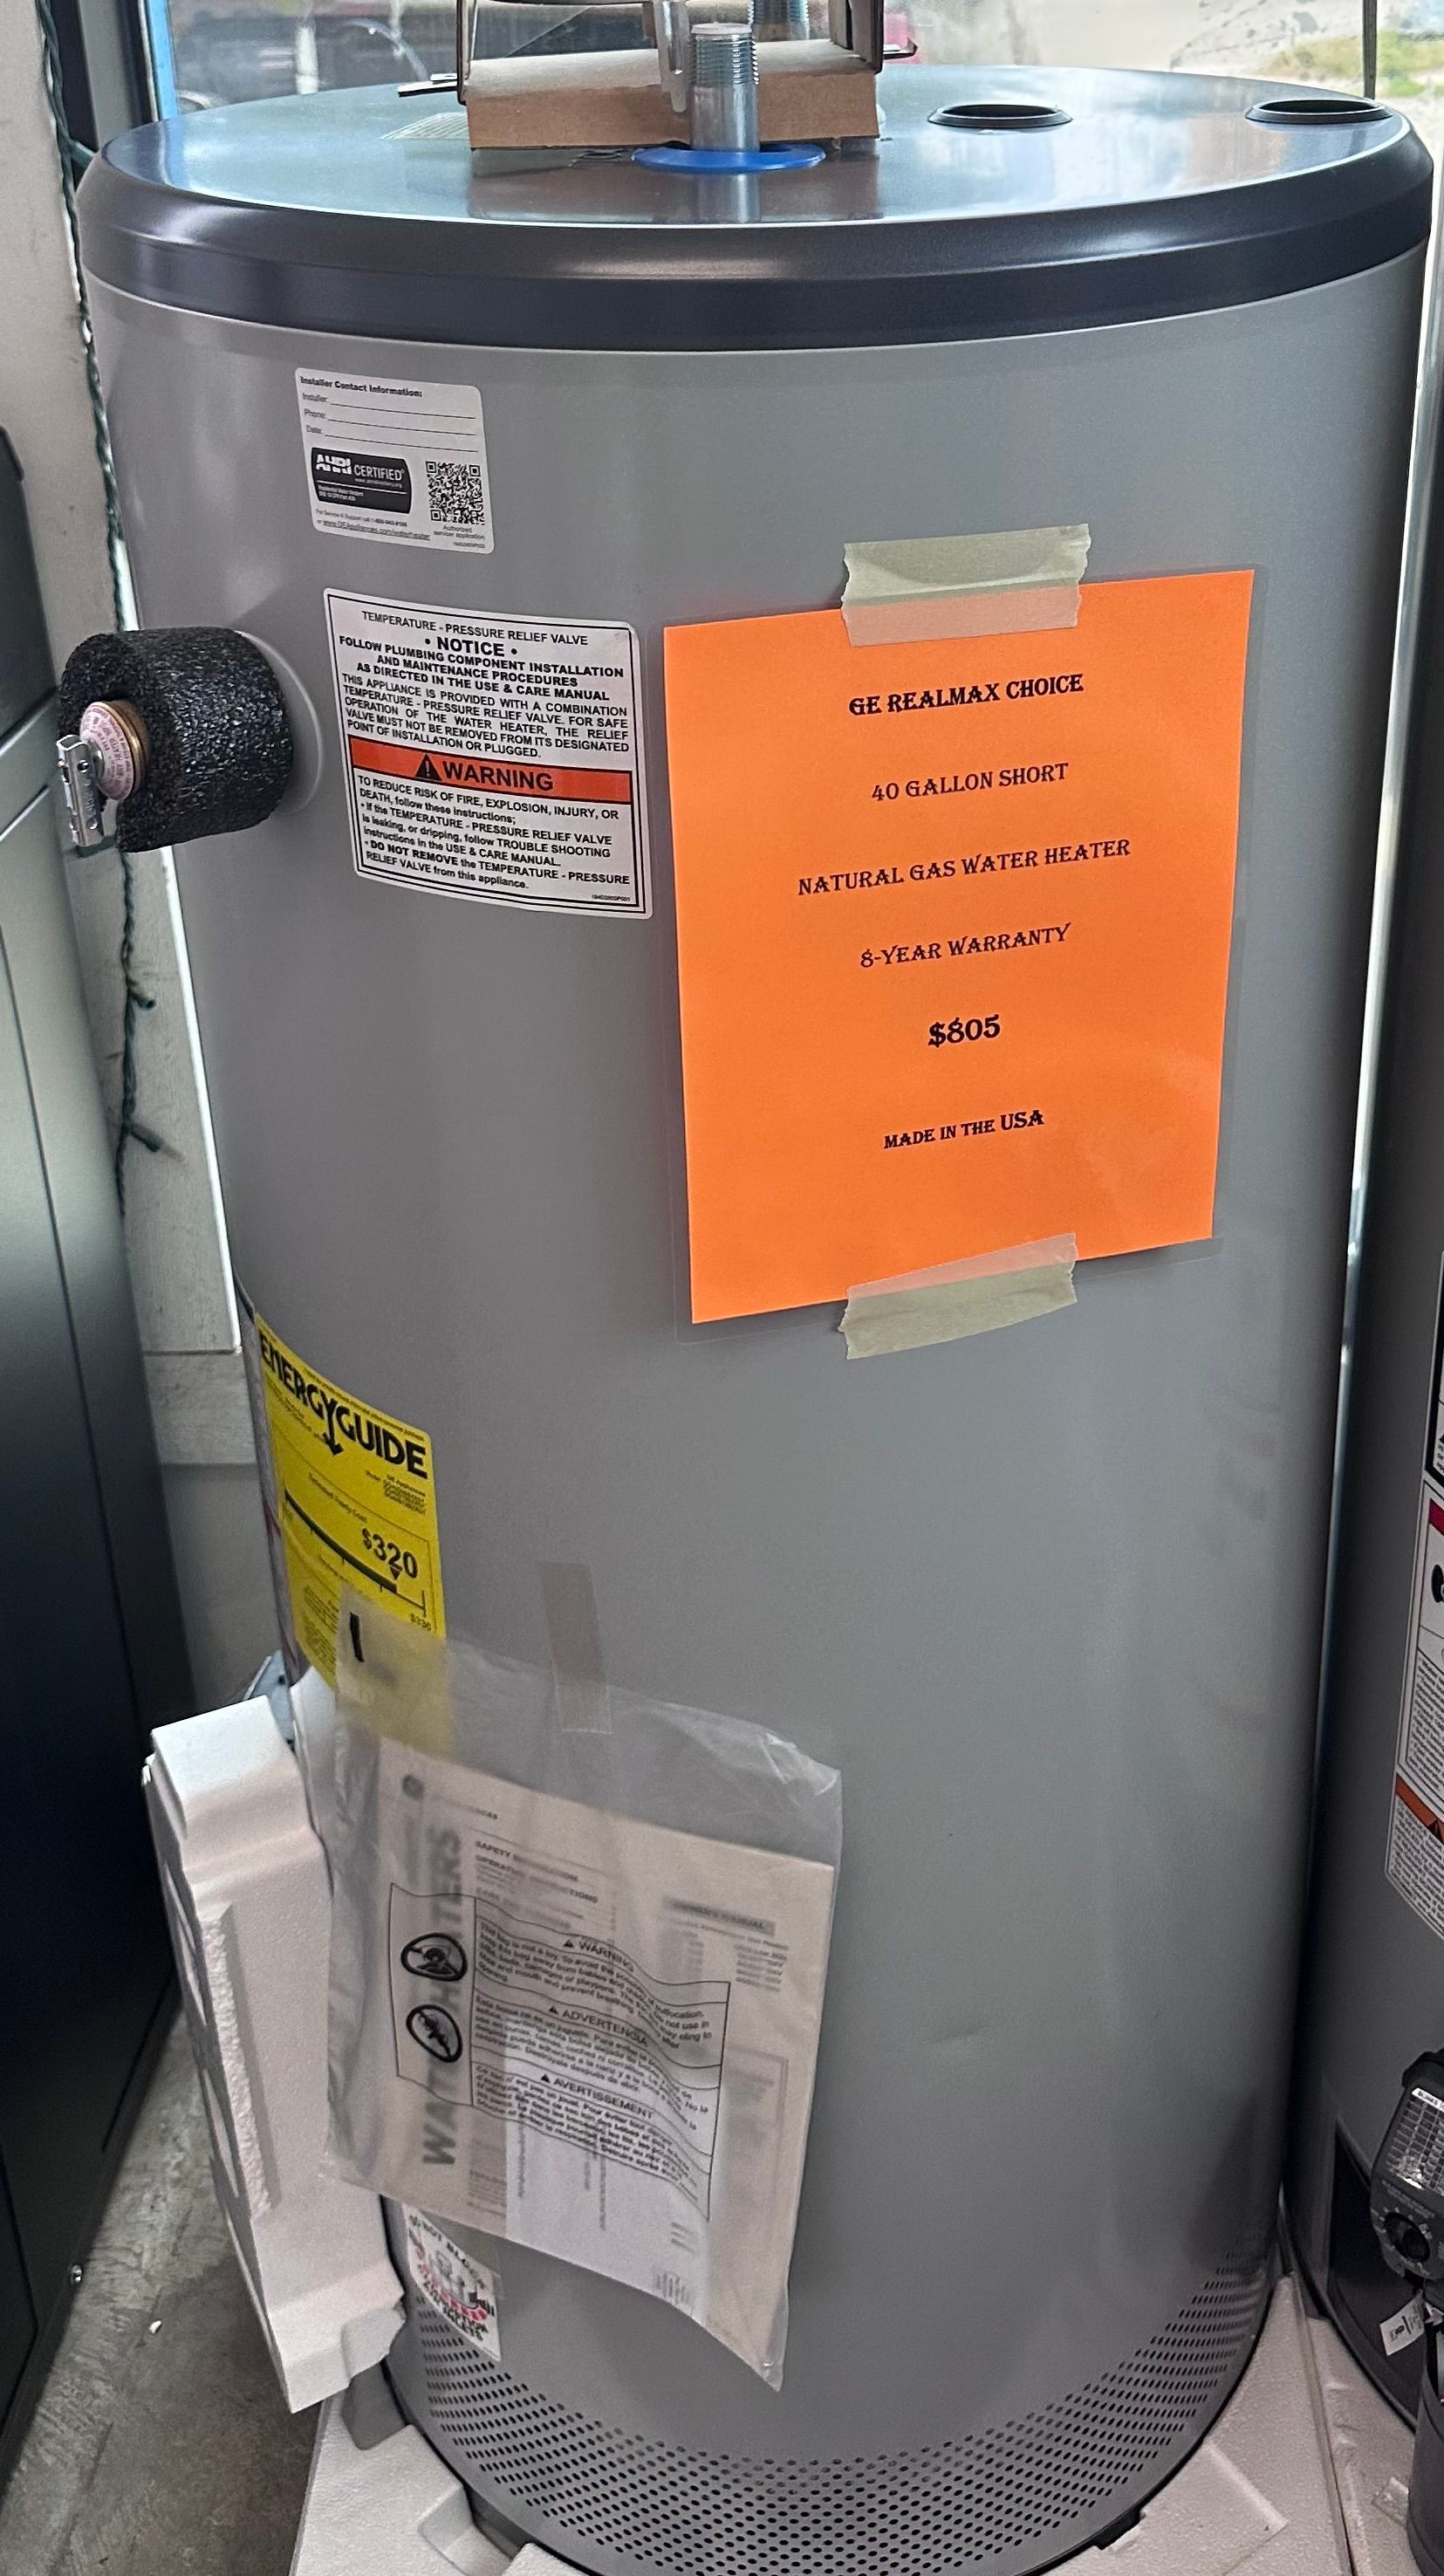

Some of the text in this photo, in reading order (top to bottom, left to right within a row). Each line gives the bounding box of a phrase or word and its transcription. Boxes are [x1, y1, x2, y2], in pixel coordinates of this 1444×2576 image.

[300, 376, 423, 397] Installer Contact Information:
[362, 611, 588, 646] TEMPERATURE PRESSURE RELIEF VALVE
[437, 636, 505, 656] NOTICE
[339, 635, 624, 677] FOLLOW PLUMBING COMPONENT INSTALLATION
[377, 654, 578, 687] AND MAINTENANCE PROCEDURES
[342, 673, 627, 717] THIS APPLIANCE IS PROVIDED WITH A COMBINATION
[357, 662, 610, 701] AS DIRECTED IN THE USE & CARE MANUAL
[849, 674, 1084, 716] GE REALMAX CHOICE
[343, 684, 628, 729] TEMPERATURE PRESSURE RELIEF VALVE. FOR SAFE
[345, 695, 629, 740] OPERATION OF THE WATER HEATER, THE RELIEF
[346, 707, 629, 752] VALVE MUST NOT BE REMOVED FROM ITS DESIGNATED
[347, 719, 542, 758] POINT OF INSTALLATION OR PLUGGED.
[442, 760, 554, 791] WARNING
[873, 763, 1069, 801] 40 GALLON SHORT
[358, 775, 619, 820] TO REDUCE RISK OF FIRE, EXPLOSION, INJURY, OR
[359, 788, 393, 805] DEATH,
[394, 795, 422, 810] follow
[425, 802, 451, 814] these
[364, 826, 415, 846] instructions
[417, 837, 427, 848] in
[428, 839, 444, 851] the
[446, 843, 467, 855] USE
[469, 846, 476, 856] &
[479, 848, 509, 861] CARE
[372, 815, 406, 833] leaking,
[420, 826, 462, 843] dripping,
[464, 833, 495, 846] follow
[497, 838, 549, 853] TROUBLE
[551, 844, 611, 858] SHOOTING
[374, 804, 388, 815] the
[389, 806, 463, 829] TEMPERATURE
[472, 822, 530, 839] PRESSURE
[532, 829, 571, 842] RELIEF
[574, 833, 613, 846] VALVE
[366, 851, 530, 889] RELIEF VALVE from this appliance.
[370, 839, 630, 884] DO NOT REMOVE the TEMPERATURE PRESSURE
[798, 839, 1131, 895] NATURAL GAS WATER HEATER
[860, 922, 1071, 968] 8-YEAR WARRANTY
[928, 1014, 1000, 1047] $805
[883, 1109, 1045, 1148] MADE IN THE USA
[362, 1528, 418, 1579] $320
[579, 1937, 634, 1973] WARNING
